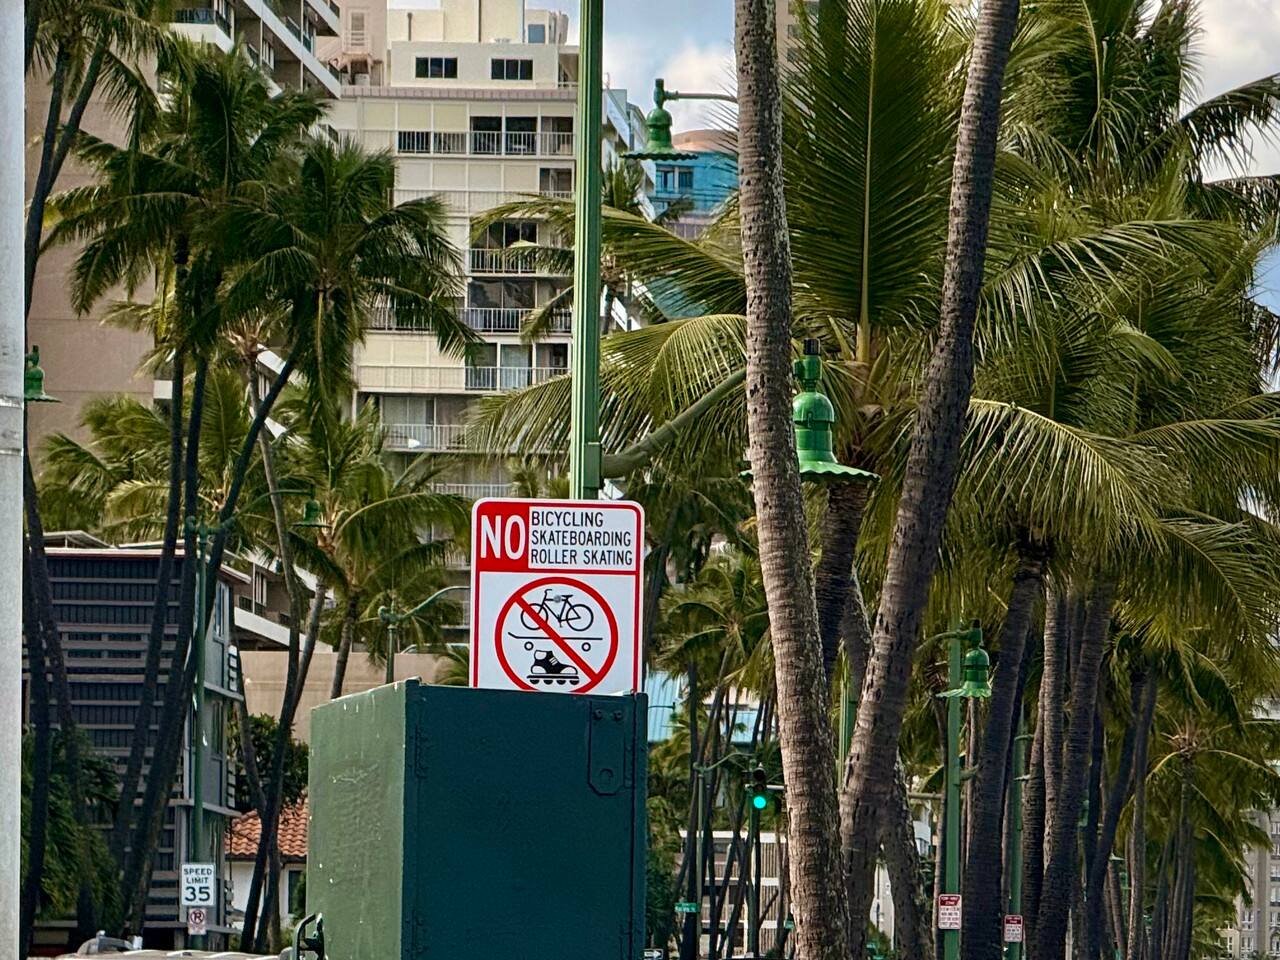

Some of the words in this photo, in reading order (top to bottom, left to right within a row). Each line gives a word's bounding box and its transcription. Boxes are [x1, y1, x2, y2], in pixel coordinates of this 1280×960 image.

[531, 511, 603, 527] BICYCLING
[480, 514, 526, 560] NO
[531, 530, 631, 547] SKATEBOARDING
[531, 549, 577, 564] ROLLER
[583, 550, 633, 565] SKATING
[185, 886, 210, 902] 35
